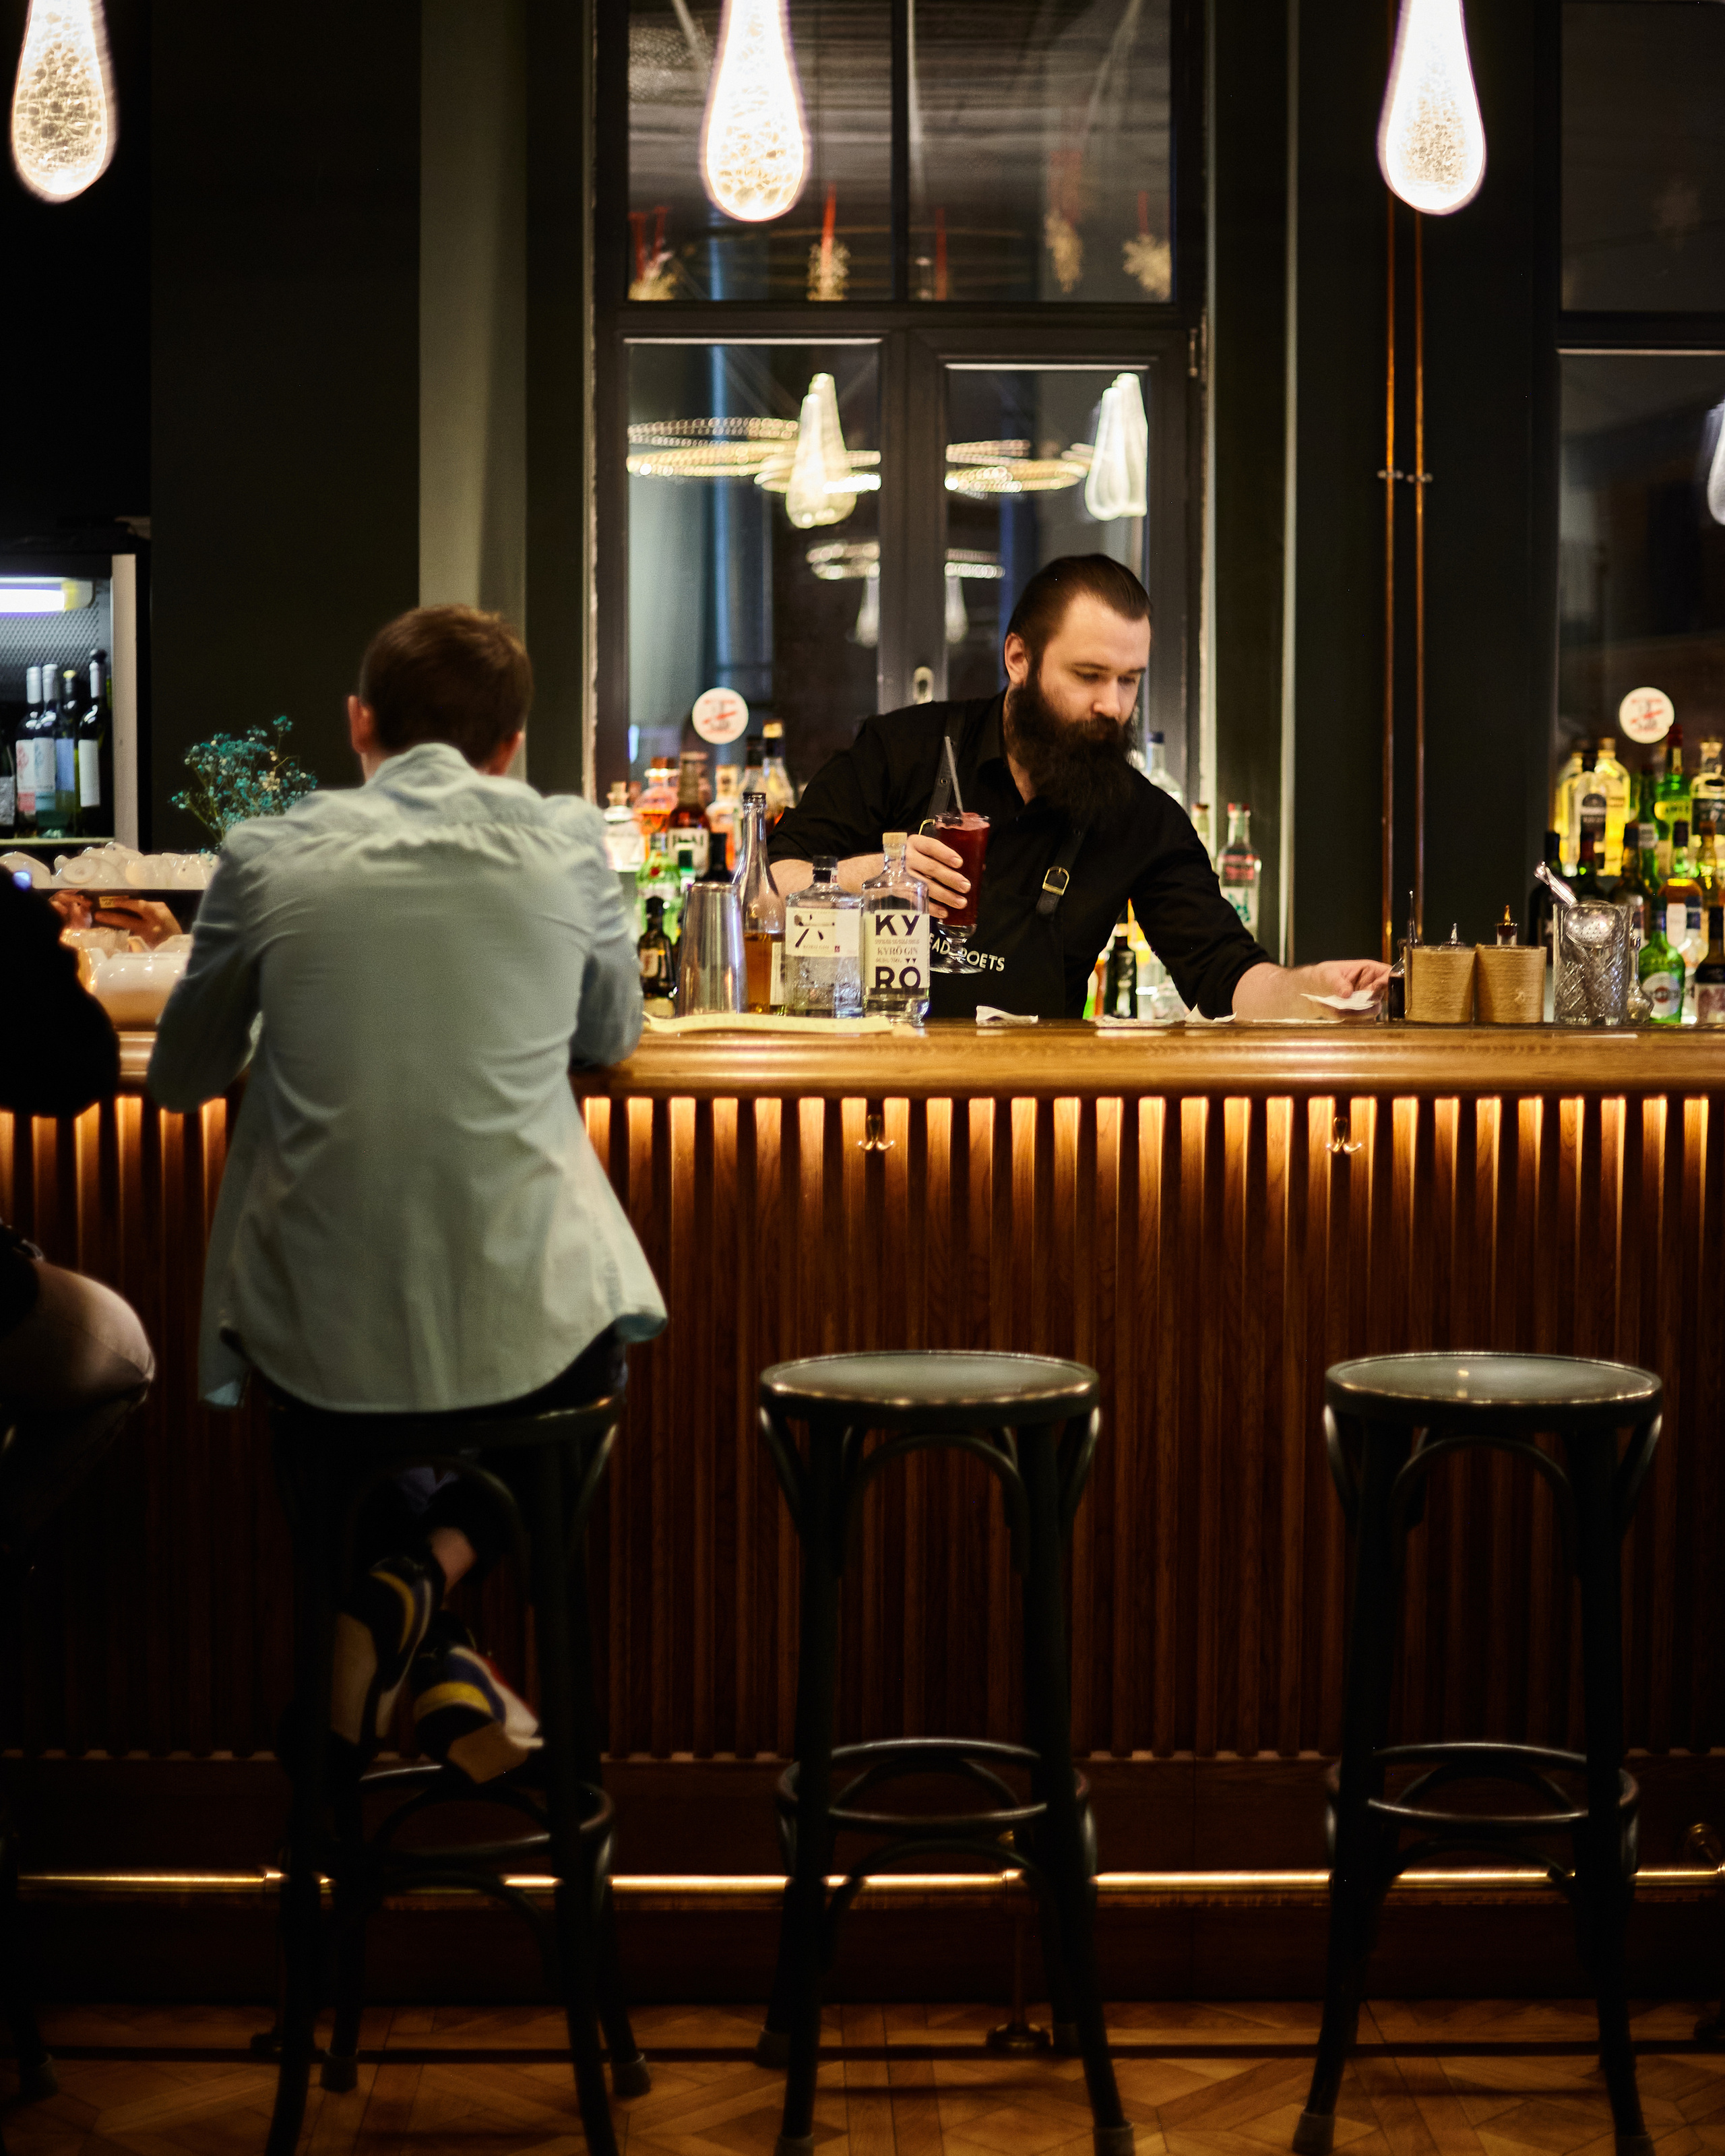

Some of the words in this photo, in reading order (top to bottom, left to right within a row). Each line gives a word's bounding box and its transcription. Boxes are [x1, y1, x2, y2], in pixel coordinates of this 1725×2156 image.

[875, 915, 920, 936] KY
[904, 946, 918, 956] GIN
[929, 933, 951, 955] EAD
